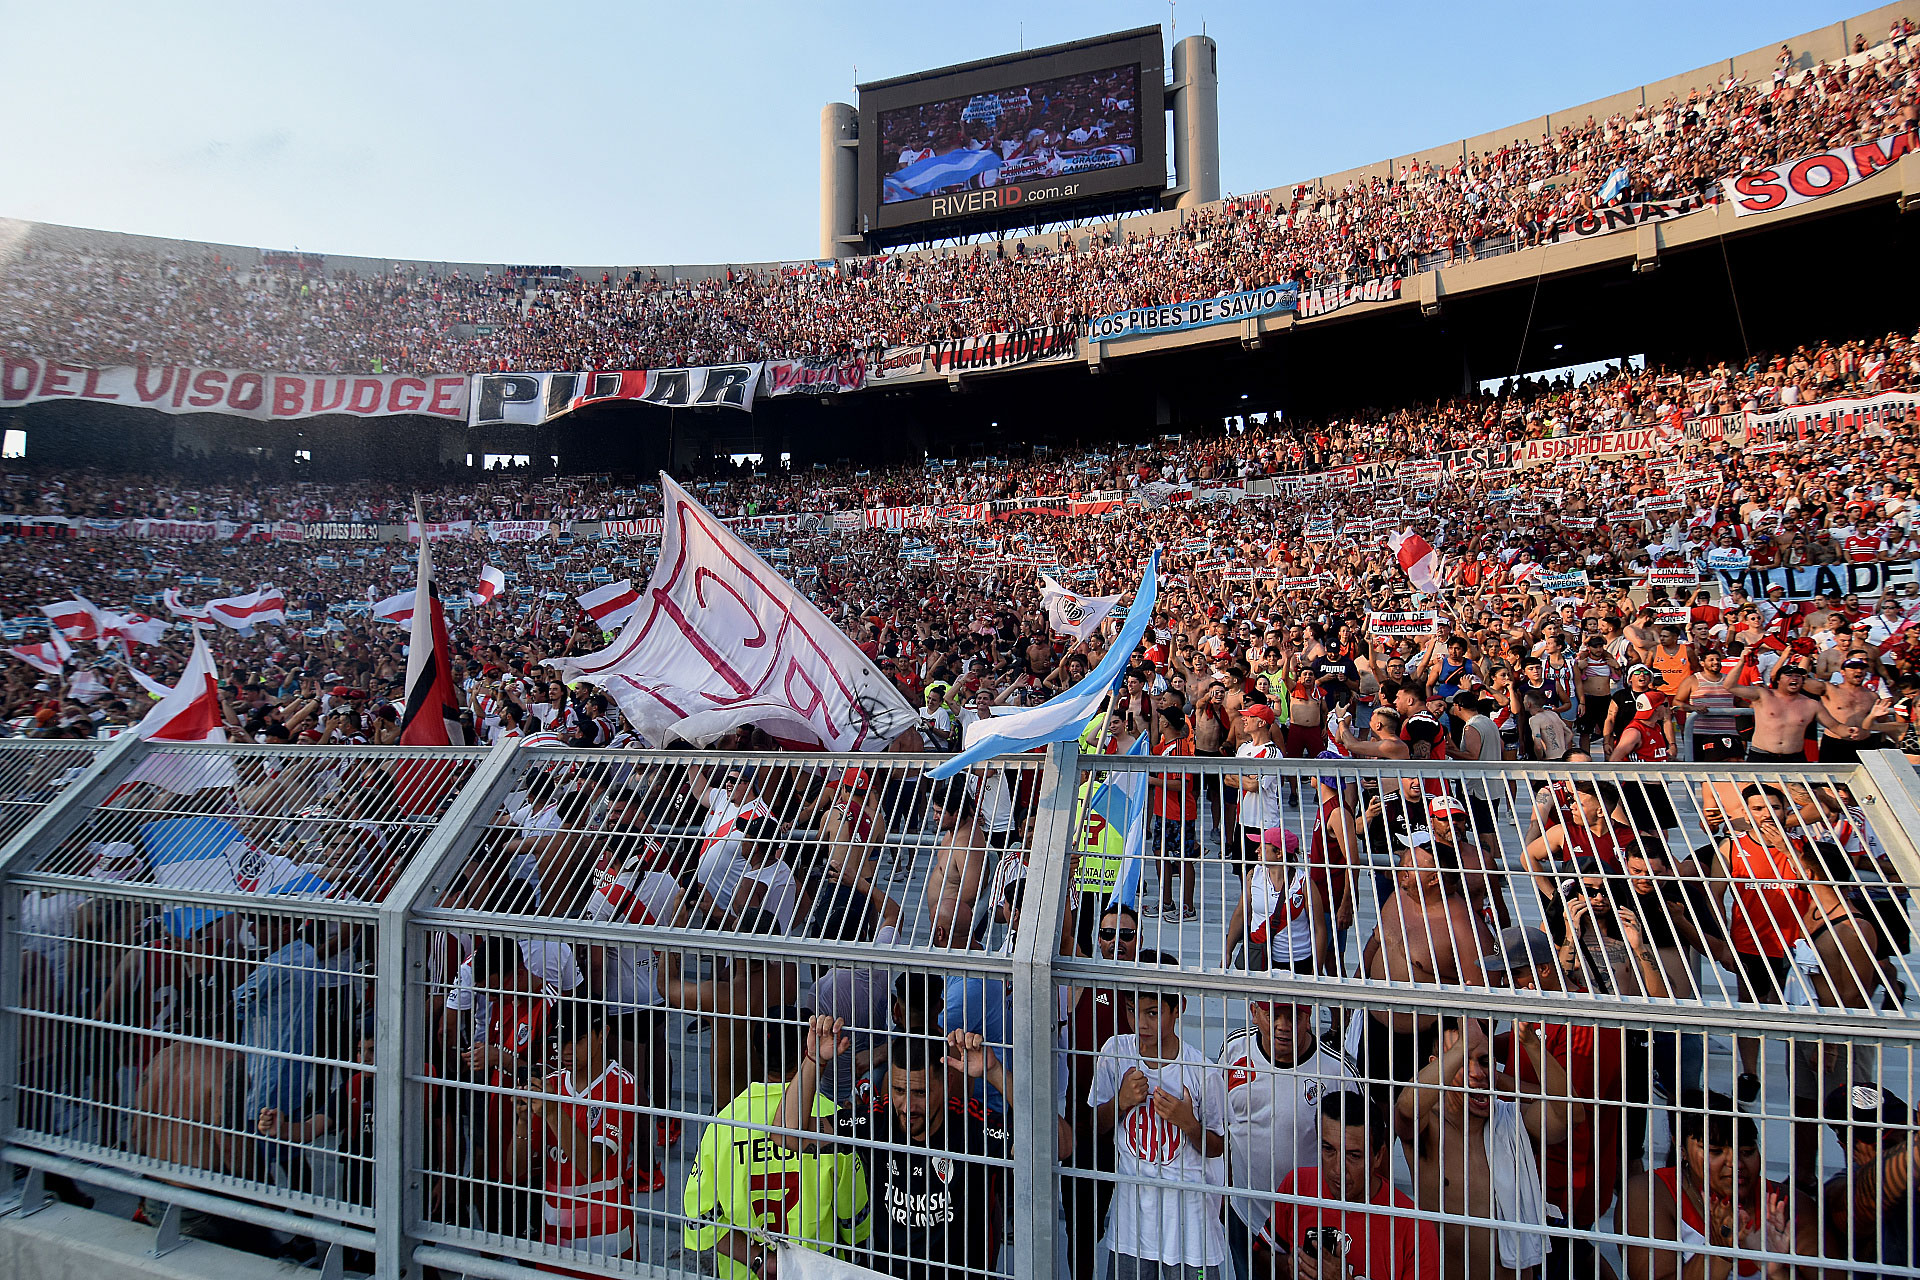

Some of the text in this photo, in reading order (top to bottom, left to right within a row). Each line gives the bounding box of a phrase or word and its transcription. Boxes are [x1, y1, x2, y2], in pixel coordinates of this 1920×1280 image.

[1299, 275, 1395, 318] TABLADA
[1091, 288, 1277, 338] LOS PIBES DE SAVIO
[931, 333, 998, 373] VILLA
[883, 351, 923, 370] DERQUI
[2, 356, 265, 411] DEL VISO
[272, 375, 464, 416] BUDGE
[988, 497, 1070, 518] RIVER Y SU GENTE
[304, 523, 321, 539] LOS
[322, 522, 349, 540] PIBES
[350, 523, 367, 540] DEL
[1714, 555, 1743, 563] GRACIAS
[1709, 562, 1749, 570] CAMPEONES
[1546, 572, 1577, 582] GRACIAS
[1656, 568, 1680, 576] CUNA
[1541, 579, 1586, 590] CAMPEONES
[1650, 576, 1697, 585] CAMPEONES
[1723, 564, 1843, 598] VILLA
[1379, 612, 1425, 623] CUNA DE
[1371, 623, 1433, 633] CAMPEONES
[1320, 664, 1346, 674] PUMA
[912, 1166, 923, 1177] 24
